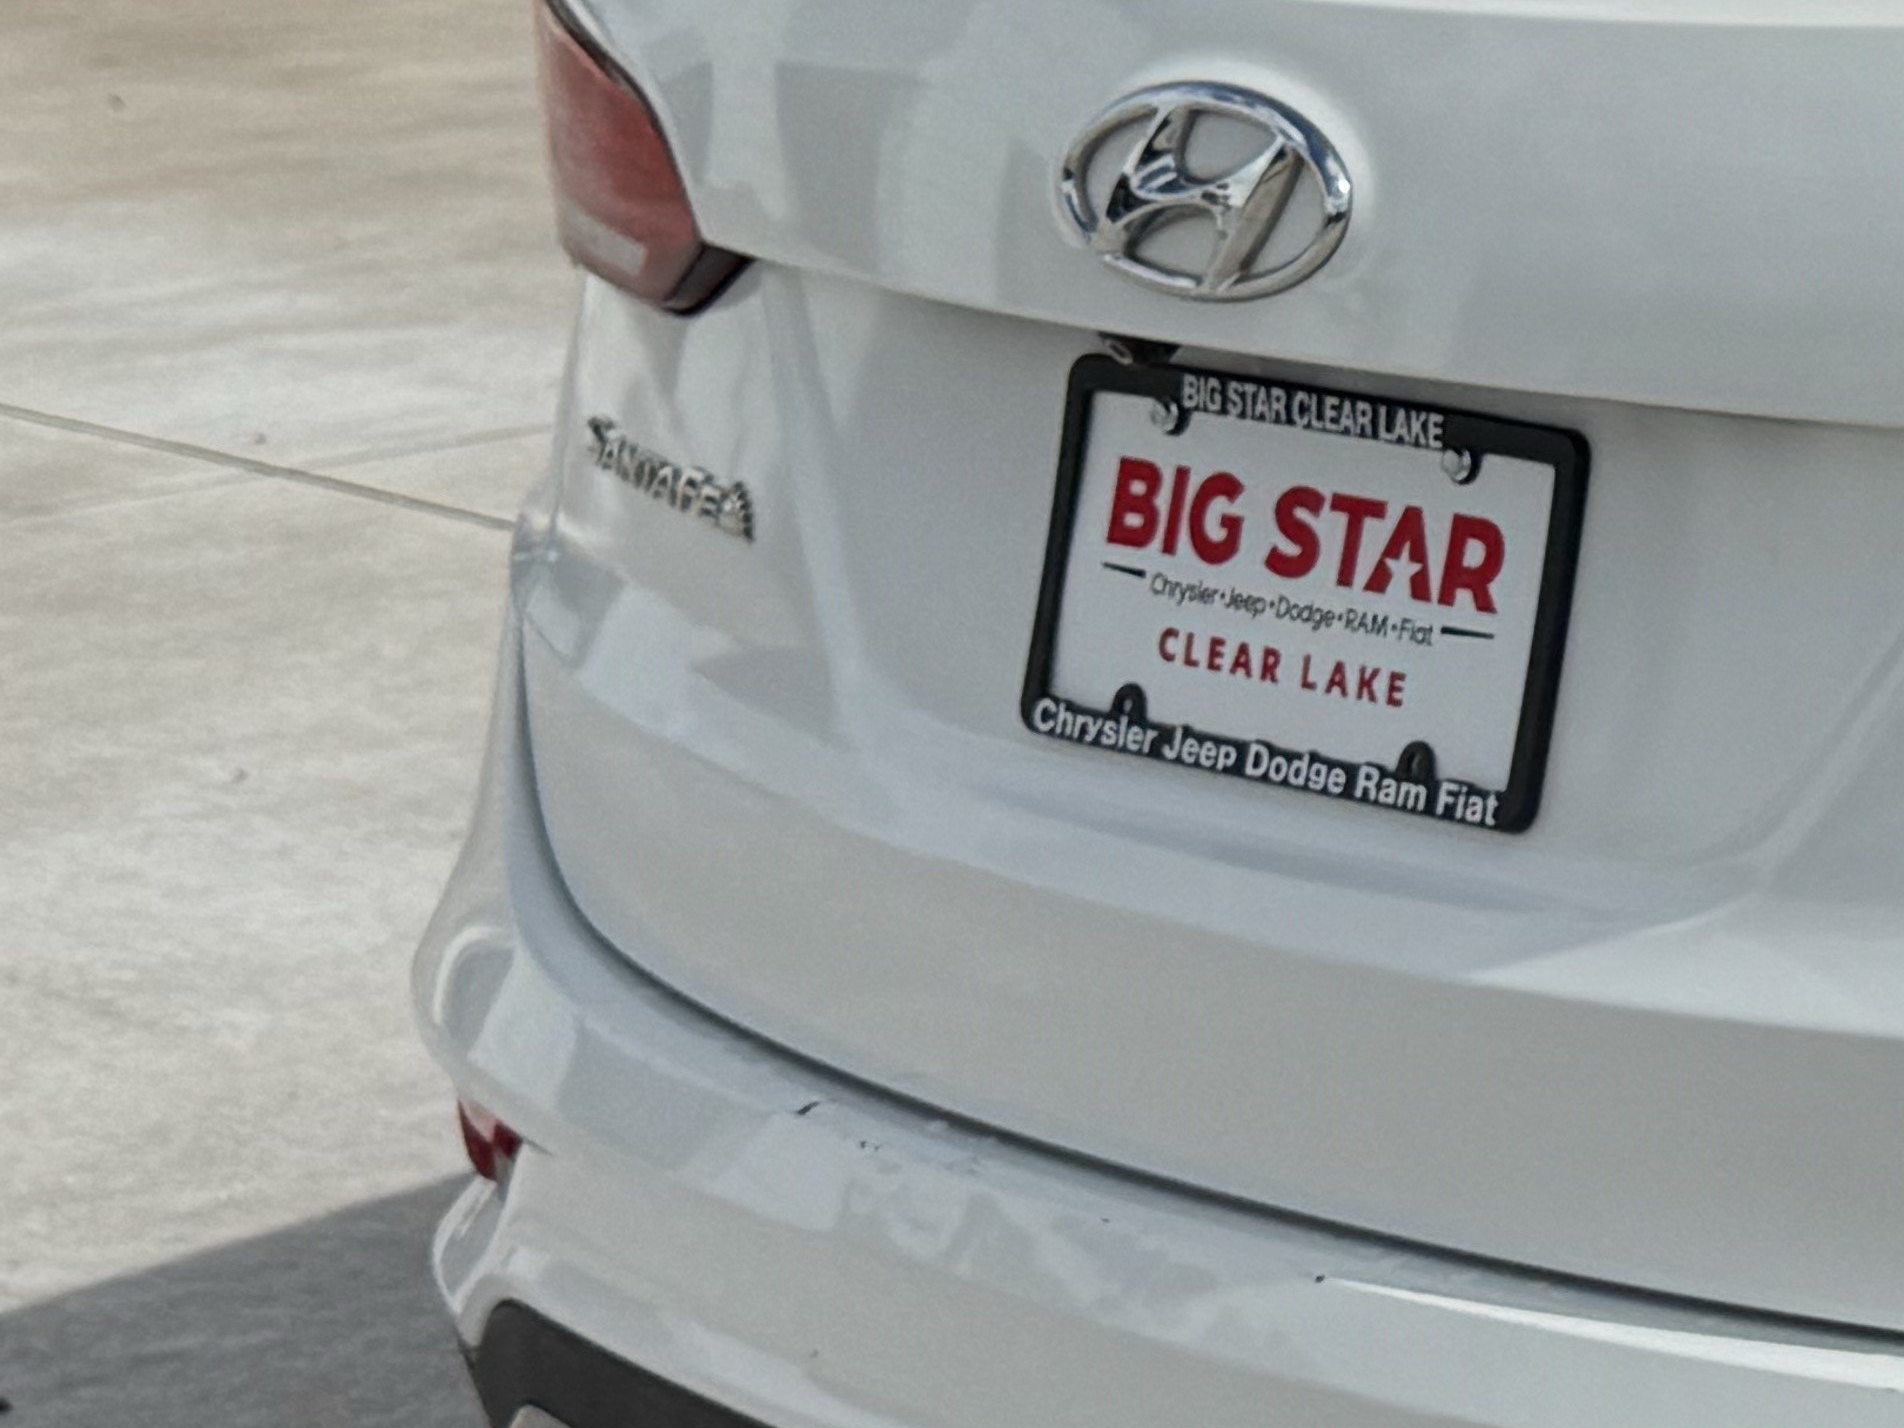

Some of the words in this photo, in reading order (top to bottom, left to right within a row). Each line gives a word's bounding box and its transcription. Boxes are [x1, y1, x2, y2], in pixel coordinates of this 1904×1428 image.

[1182, 372, 1223, 412] BIG
[1226, 380, 1287, 423] STAR
[1291, 390, 1374, 437] CLEAR
[1378, 404, 1445, 449] LAKE
[1106, 455, 1246, 565] BIG
[1264, 485, 1506, 614] STAR
[1157, 626, 1282, 685] CLEAR
[1300, 653, 1408, 709] LAKE
[1030, 697, 1159, 753] Chrysler
[1161, 726, 1238, 772] Jeep
[1244, 745, 1347, 797] Dodge
[1353, 769, 1428, 811] Ram
[1435, 781, 1499, 828] Fiat
